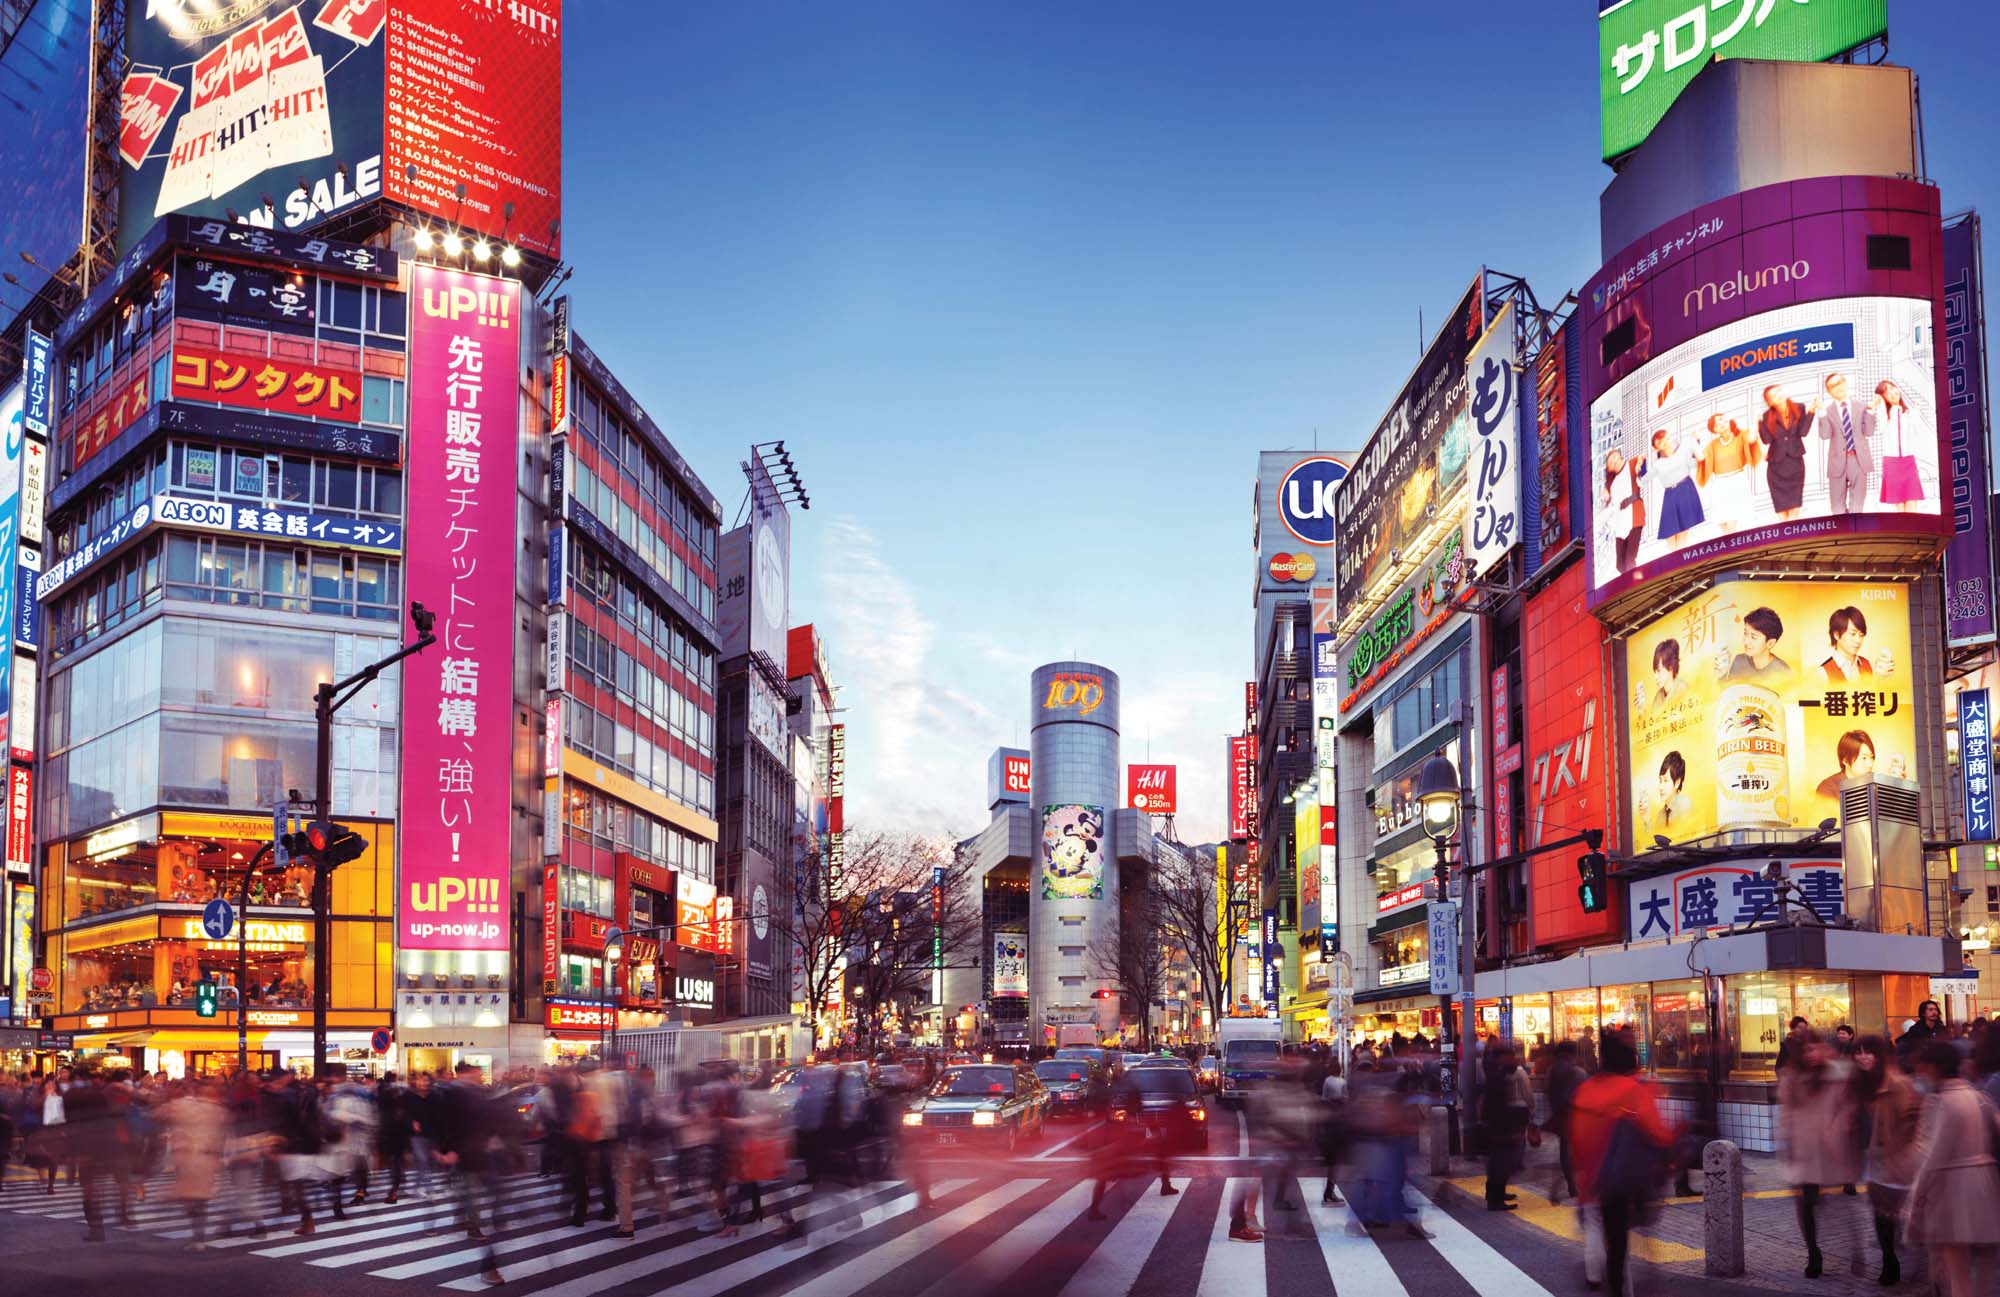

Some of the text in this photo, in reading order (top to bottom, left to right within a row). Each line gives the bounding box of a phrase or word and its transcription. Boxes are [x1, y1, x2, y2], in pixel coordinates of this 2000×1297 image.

[390, 8, 463, 45] 01. Everybody Go
[507, 0, 558, 38] HIT!
[389, 34, 405, 47] 03.
[390, 21, 406, 34] 02.
[407, 27, 422, 41] We
[424, 36, 447, 51] never
[447, 46, 465, 58] give
[389, 47, 405, 61] 04.
[407, 54, 445, 78] WANNA
[389, 61, 405, 74] 05.
[406, 69, 431, 85] Shake
[441, 81, 454, 95] Up
[389, 74, 405, 88] 06.
[389, 88, 405, 101] 07.
[269, 86, 325, 122] HIT!
[389, 101, 405, 114] 08.
[406, 108, 419, 123] My
[421, 114, 464, 138] Resistance
[389, 114, 404, 128] 09.
[217, 104, 268, 151] HIT!
[170, 130, 216, 170] HIT!
[389, 156, 403, 169] 12.
[389, 142, 404, 156] 11.
[431, 157, 457, 175] (Smile
[459, 168, 472, 181] On
[473, 174, 498, 191] Smile)
[390, 128, 404, 142] 10.
[475, 161, 494, 176] KISS
[496, 169, 522, 186] YOUR
[523, 182, 548, 197] MIND
[284, 155, 381, 229] SALE
[389, 169, 403, 182] 13.
[388, 183, 440, 208] 14. Luv Sick
[196, 261, 212, 271] 9F
[1607, 217, 1724, 298] わかさ生活 チャンネル
[423, 285, 511, 329] uP!!!
[1683, 259, 1810, 319] melumo
[1720, 339, 1832, 375] PROMISE プロミス
[175, 354, 357, 408] コンタクト
[1413, 363, 1449, 421] NEW ALBUM
[75, 377, 148, 457] プライス
[170, 410, 185, 424] 7F
[630, 401, 644, 422] 9F
[1339, 398, 1410, 525] OLDCODEX
[1471, 356, 1514, 551] もんじゃ
[1347, 494, 1381, 538] Silent,
[1384, 440, 1417, 492] within
[1421, 410, 1440, 440] the
[1952, 418, 1974, 535] neon
[27, 464, 39, 528] 献血ルーム
[161, 500, 226, 526] AEON
[237, 507, 395, 545] 英会話イーオン
[1682, 521, 1837, 560] WAKASA SEIKATSU CHANNEL
[38, 519, 131, 597] AEON 英会話イーオン
[1269, 562, 1316, 572] MasterCard
[1340, 523, 1378, 590] 2014.4.2
[1860, 589, 1897, 600] KIRIN
[1952, 592, 1985, 609] 3719
[1955, 578, 1982, 594] (03)
[1682, 594, 1738, 655] 新
[1952, 605, 1986, 620] 2468
[549, 620, 559, 684] 渋谷駅前ビル
[1055, 672, 1103, 684] SHIBUYA
[547, 701, 560, 710] 5F
[1042, 680, 1104, 716] 109
[1495, 671, 1506, 747] お好み焼
[1798, 690, 1900, 718] 一番搾り
[1717, 739, 1784, 757] KIRIN BEER
[1964, 700, 1989, 832] 大盛堂商事ビル
[1137, 769, 1167, 790] H&M
[1234, 740, 1247, 836] Essential
[1731, 779, 1770, 790] 一番搾り
[1148, 800, 1171, 809] 150m
[411, 876, 499, 913] uP!!!
[1639, 870, 1844, 938] 大盛堂書
[411, 921, 500, 939] up-now.jp
[682, 905, 709, 929] アコム
[1266, 916, 1274, 944] MIZUHO
[691, 933, 700, 944] 3F
[1432, 910, 1447, 981] 文化村通り
[996, 960, 1025, 976] 学割
[406, 994, 500, 1005] 渋谷駅前ビル
[675, 976, 713, 1002] LUSH
